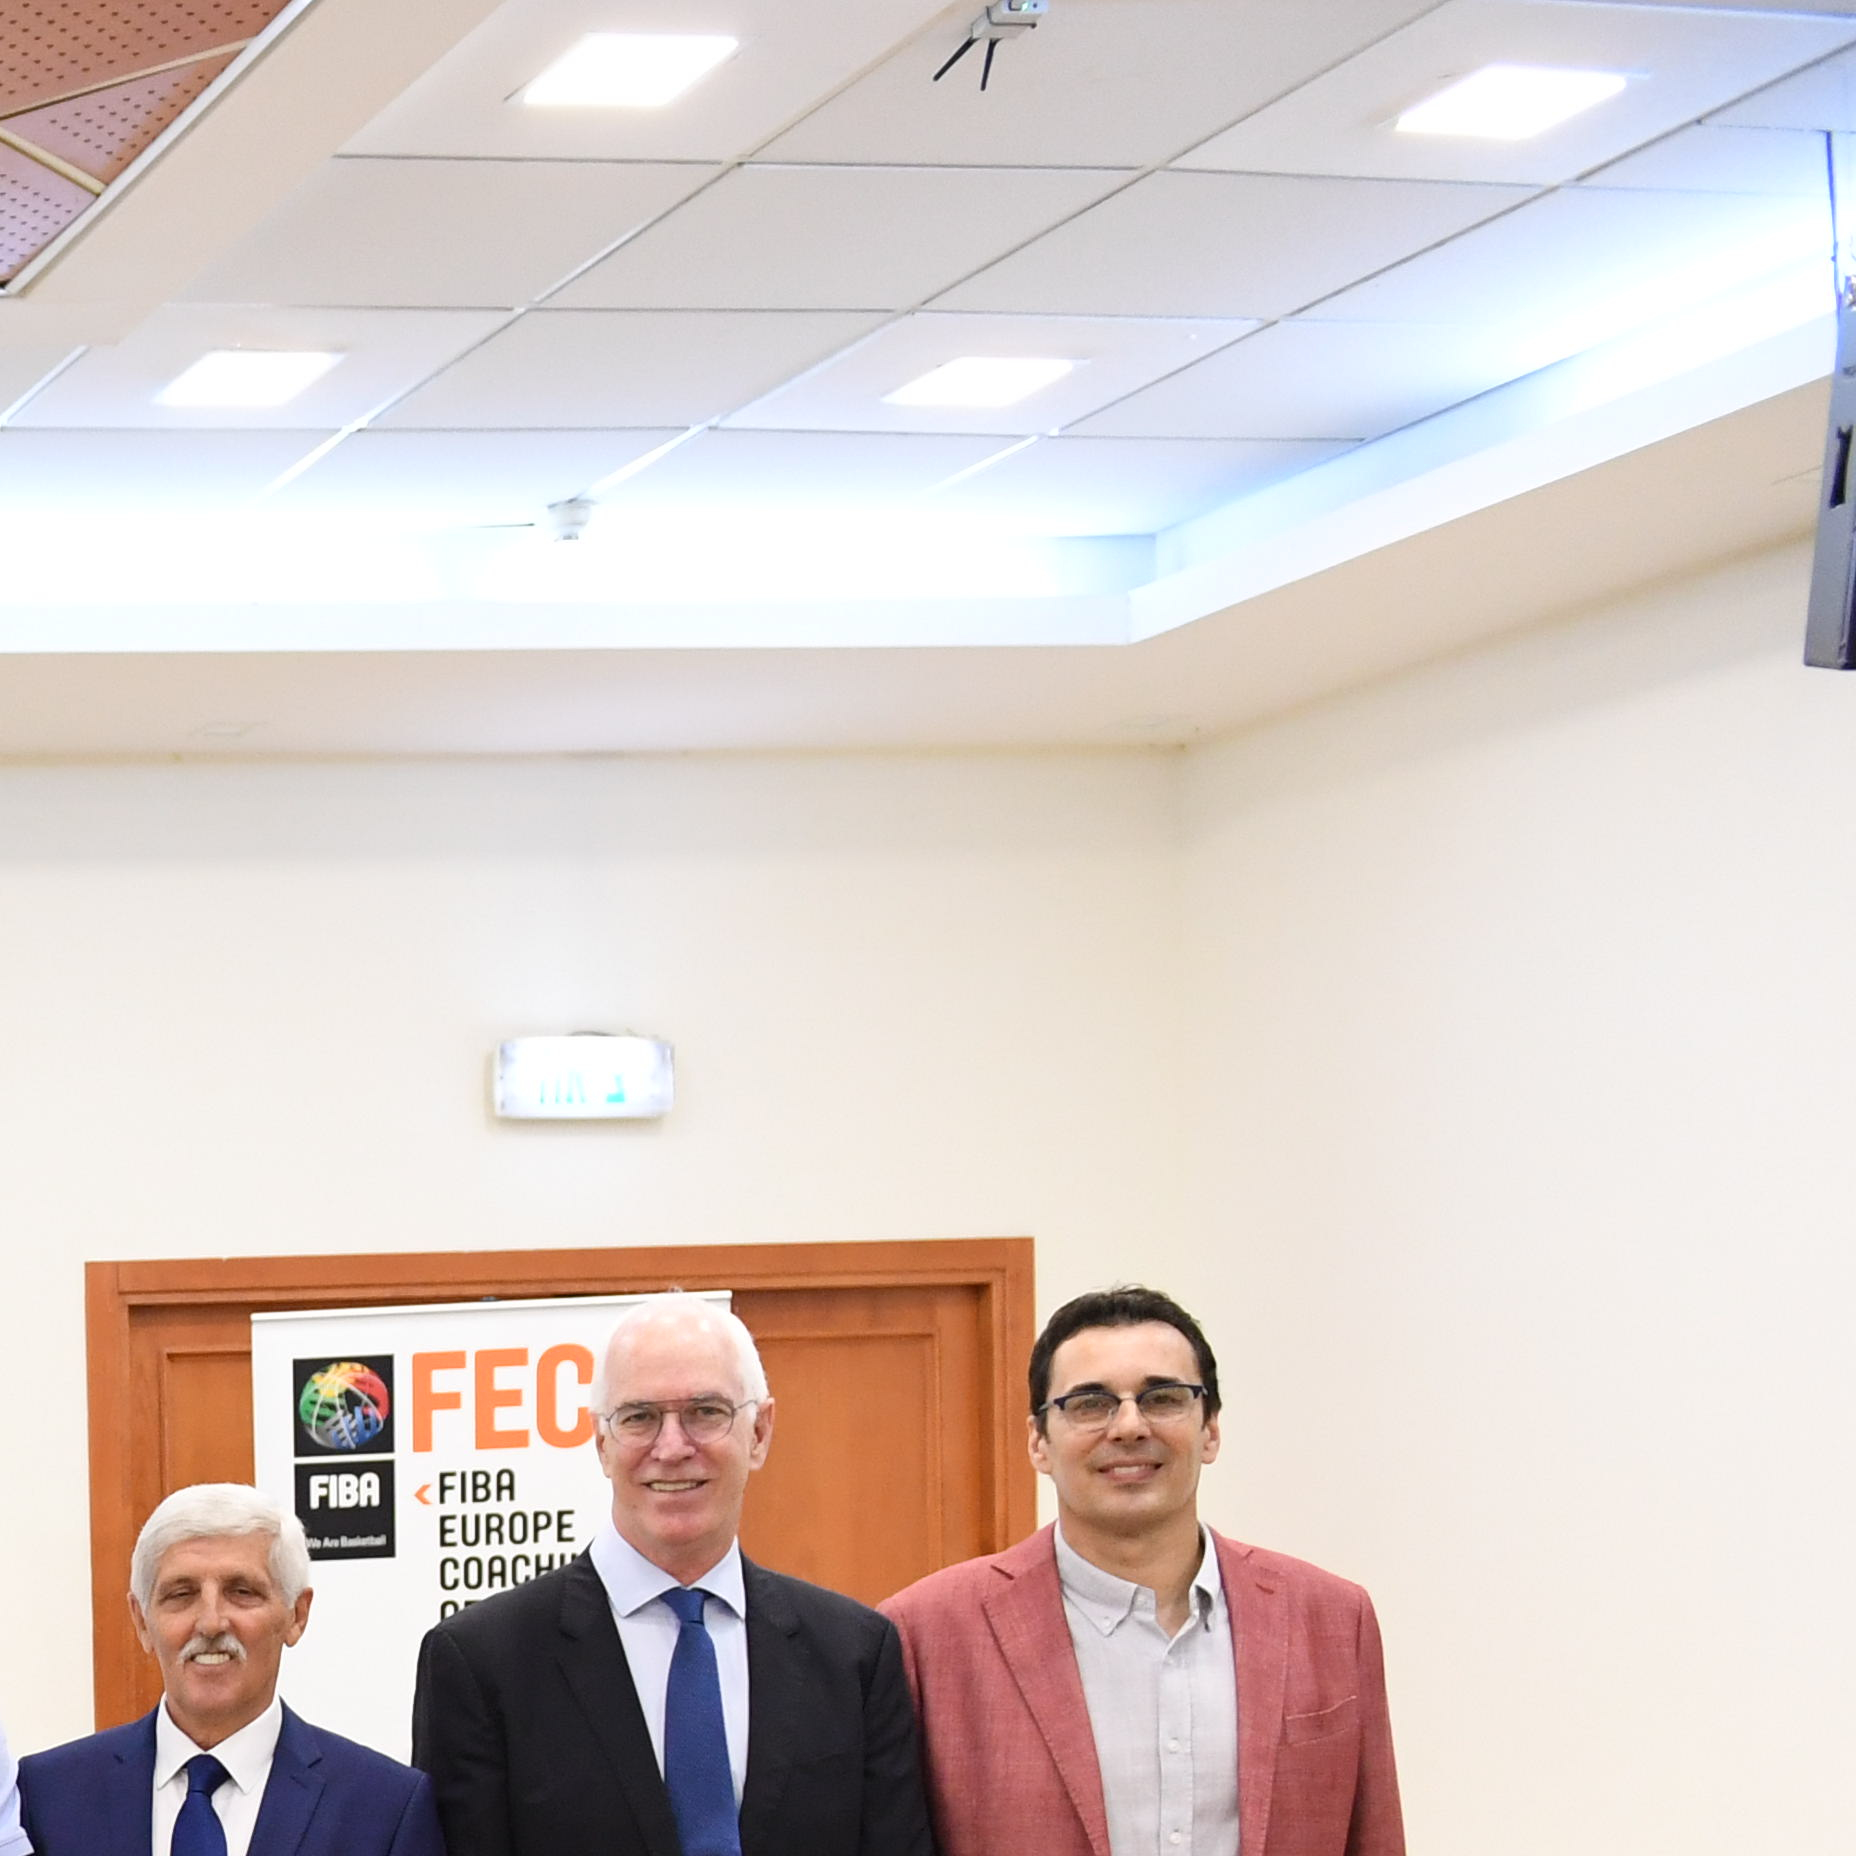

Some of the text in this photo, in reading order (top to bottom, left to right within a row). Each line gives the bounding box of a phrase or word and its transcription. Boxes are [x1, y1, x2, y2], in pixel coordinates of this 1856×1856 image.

[411, 1344, 594, 1453] FEC
[310, 1471, 380, 1510] FIBA
[439, 1468, 515, 1504] FIBA
[439, 1509, 576, 1548] EUROPE
[439, 1553, 578, 1591] COACH
